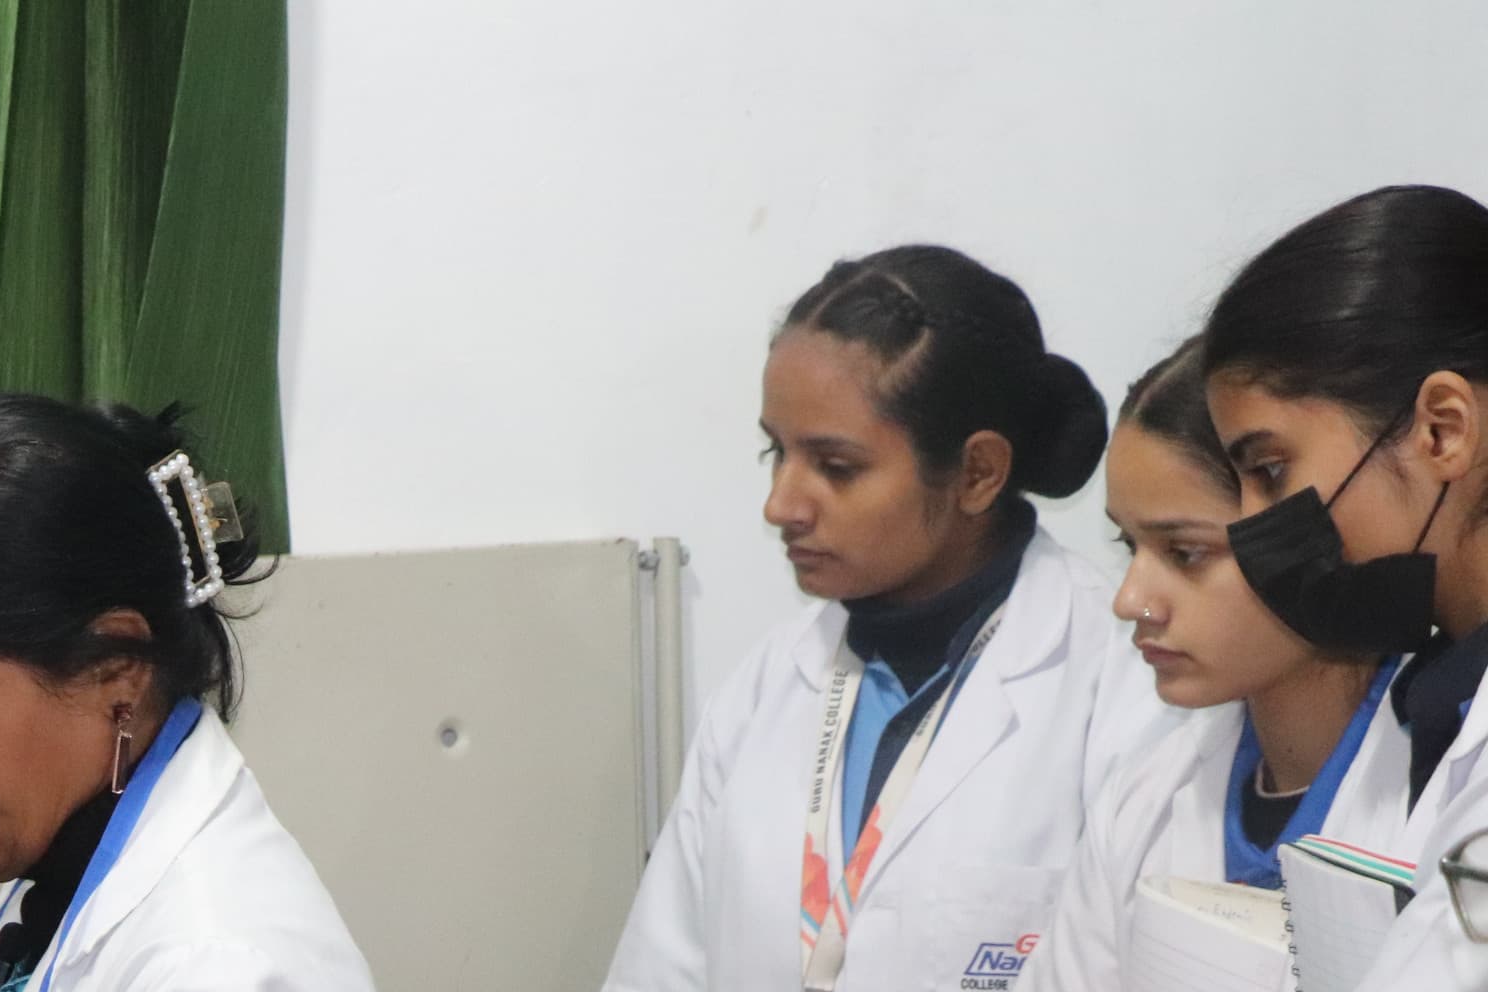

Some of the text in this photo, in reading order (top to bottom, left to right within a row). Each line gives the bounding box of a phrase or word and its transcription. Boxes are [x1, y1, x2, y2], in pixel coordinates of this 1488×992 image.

[824, 669, 850, 728] COLLEGE
[816, 730, 834, 775] NANAK
[811, 778, 824, 814] GURU
[960, 978, 1009, 991] COLLEGE
